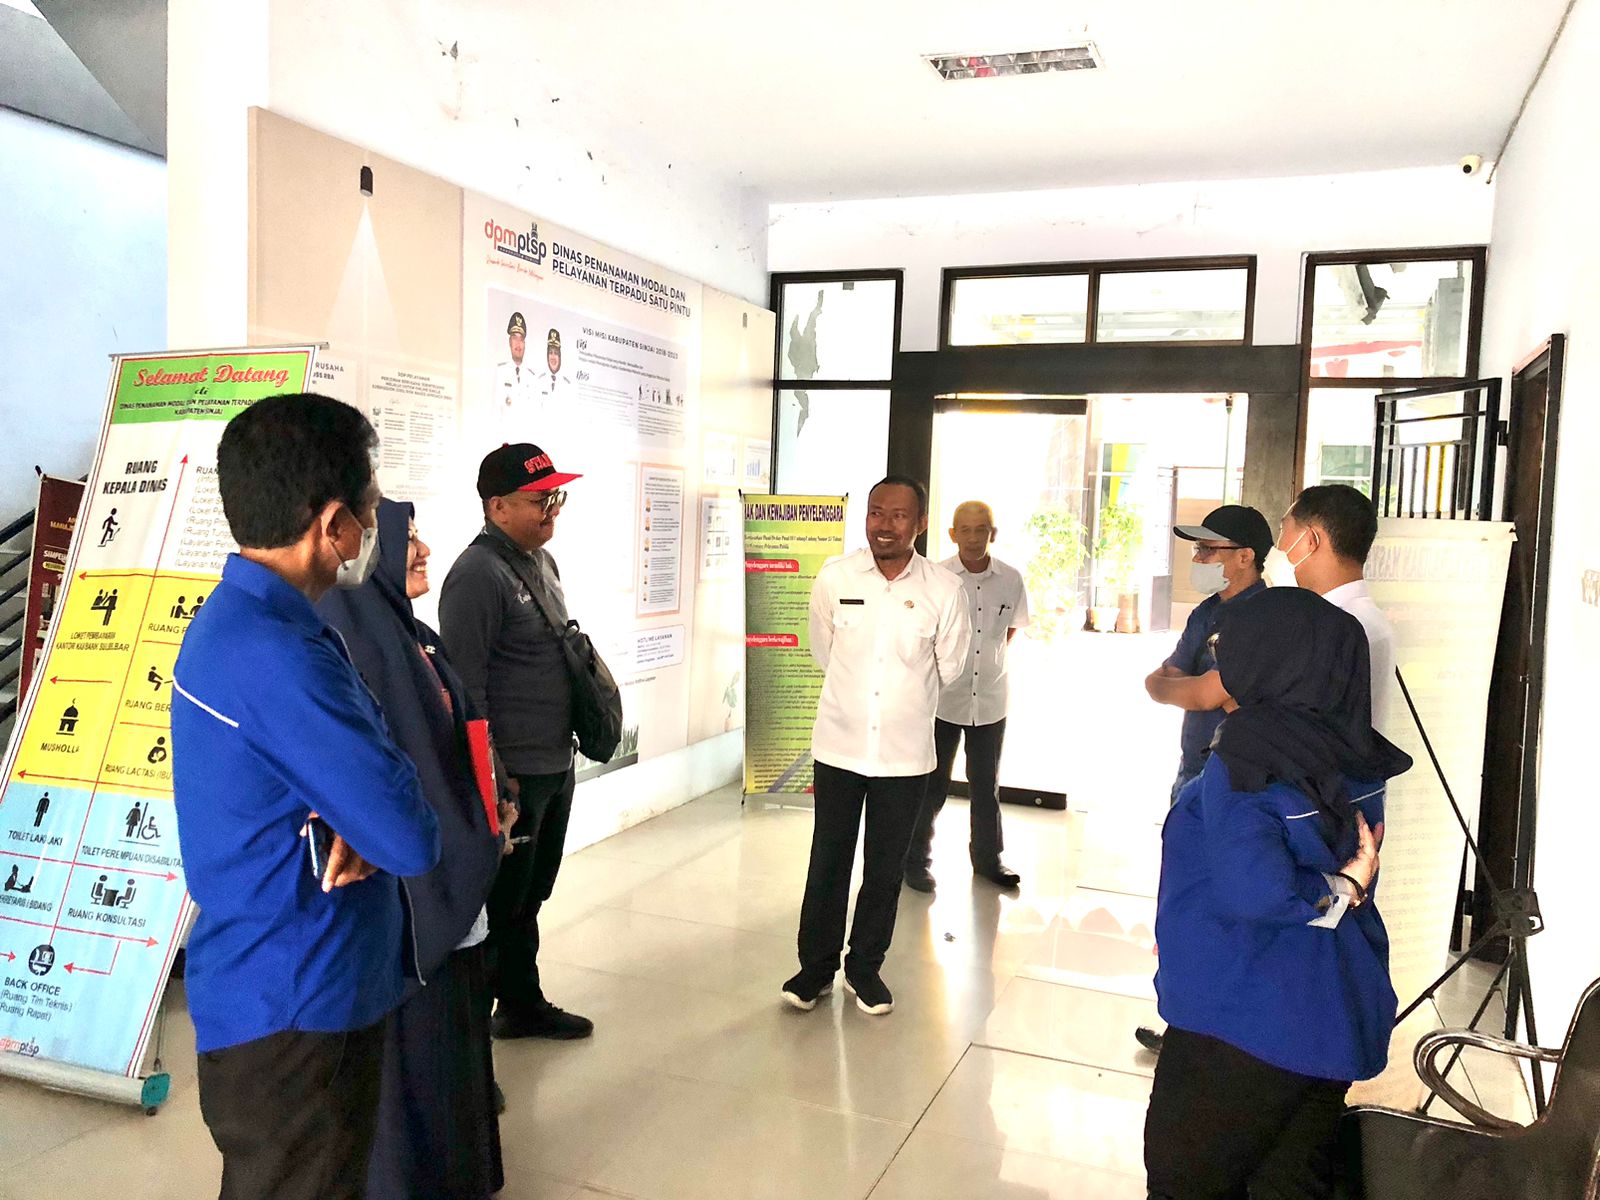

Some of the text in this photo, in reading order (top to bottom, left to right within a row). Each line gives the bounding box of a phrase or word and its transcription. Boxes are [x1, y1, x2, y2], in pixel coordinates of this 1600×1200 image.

[484, 218, 547, 264] dpmptsp
[552, 241, 583, 264] DINAS
[584, 254, 640, 286] PENANAMAN
[641, 276, 669, 297] MODAL
[670, 287, 686, 302] DAN
[552, 258, 608, 290] PELAYANAN
[609, 279, 648, 303] TERPADU
[649, 294, 669, 310] SATU
[669, 301, 691, 318] PINTU
[582, 327, 594, 336] VISI
[595, 330, 607, 340] MISI
[607, 334, 639, 349] KABUPATEN
[639, 343, 655, 353] SINJAI
[133, 362, 289, 388] Selamat Datang
[315, 361, 344, 372] RUSAHA
[194, 386, 210, 396] di
[125, 460, 158, 475] RUANG
[196, 466, 218, 475] RUAN
[103, 478, 168, 495] KEPALA DINAS
[755, 503, 767, 520] DAN
[767, 503, 798, 521] KEWAJIBAN
[799, 504, 844, 522] PENYELENGGARA
[147, 622, 180, 635] RUANG
[125, 699, 152, 711] RUANG
[104, 763, 125, 775] RUANG
[126, 765, 157, 778] LACTASI
[8, 830, 30, 842] TOILET
[82, 845, 182, 867] TOILET PEREMPUAN DISABILITA
[29, 899, 53, 912] BIDANG
[68, 907, 146, 928] RUANG KONSULTASI
[4, 976, 61, 996] BACK OFFICE
[0, 989, 73, 1012] (Ruang Tim Teknis)
[0, 1002, 52, 1022] Ruang Rapat)
